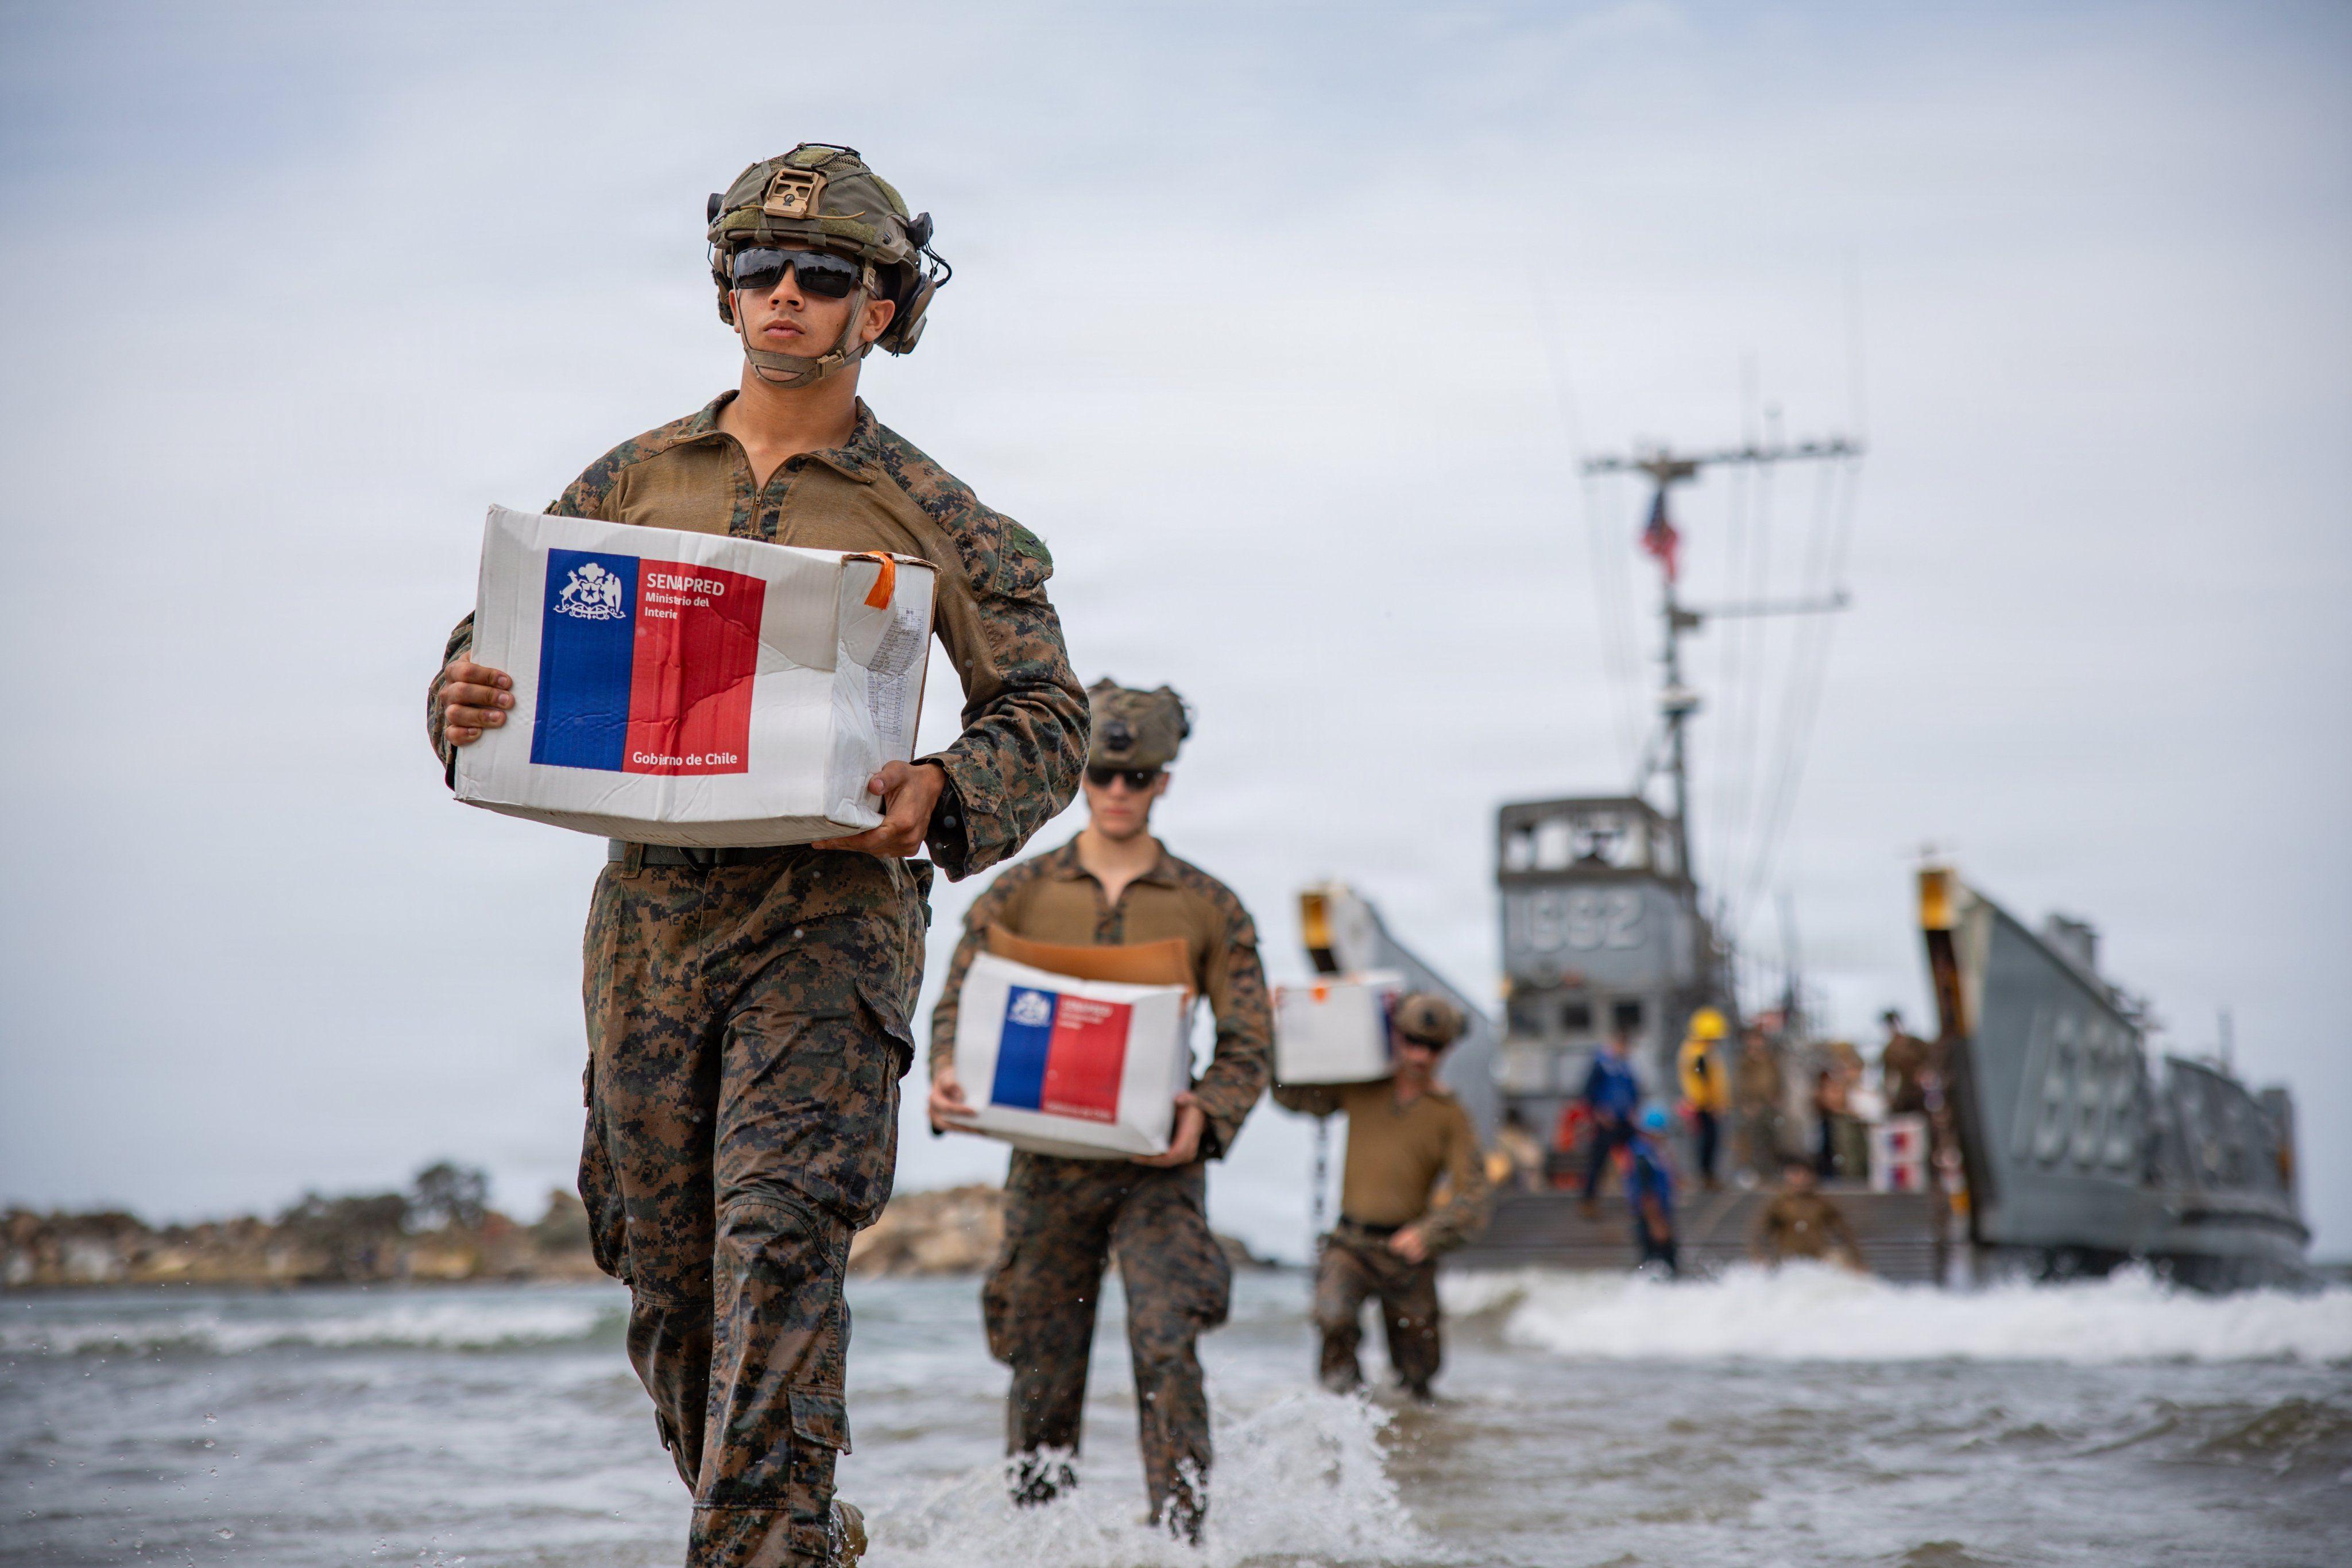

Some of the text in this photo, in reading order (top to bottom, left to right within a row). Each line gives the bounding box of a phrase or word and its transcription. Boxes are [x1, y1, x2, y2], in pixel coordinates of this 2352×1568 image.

[647, 573, 725, 596] SENAPRED
[694, 596, 709, 607] del
[686, 753, 702, 765] de
[705, 752, 738, 765] Chile
